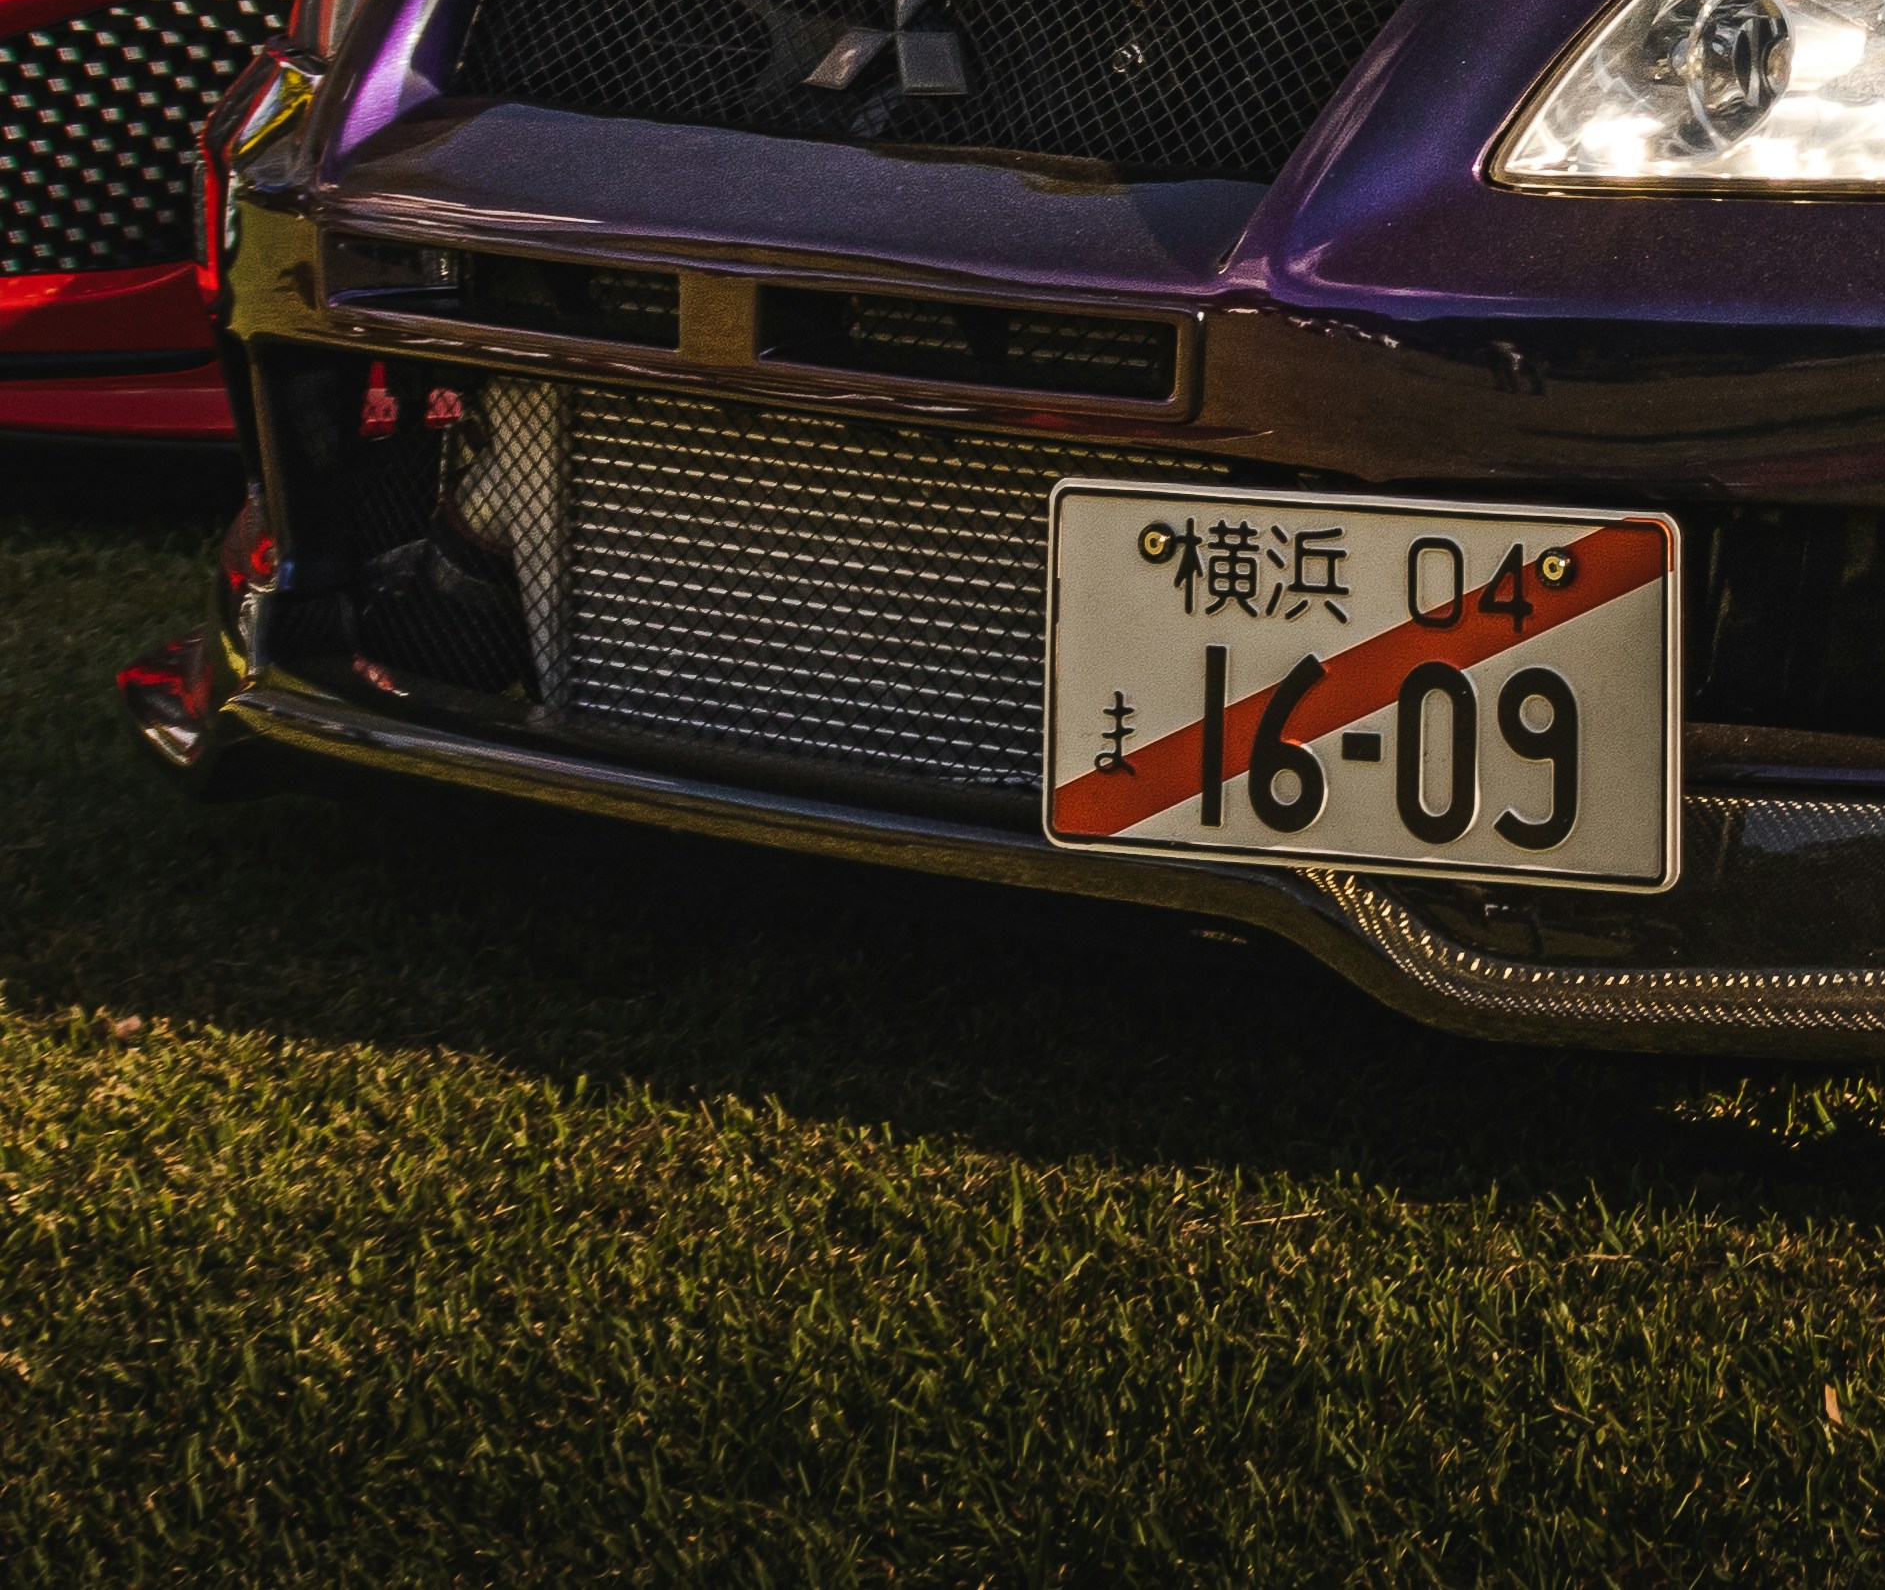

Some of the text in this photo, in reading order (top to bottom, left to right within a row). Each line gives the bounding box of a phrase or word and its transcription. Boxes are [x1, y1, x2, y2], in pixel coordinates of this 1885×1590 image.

[1174, 517, 1533, 633] 横浜 04
[1094, 644, 1578, 851] ま 16-09
